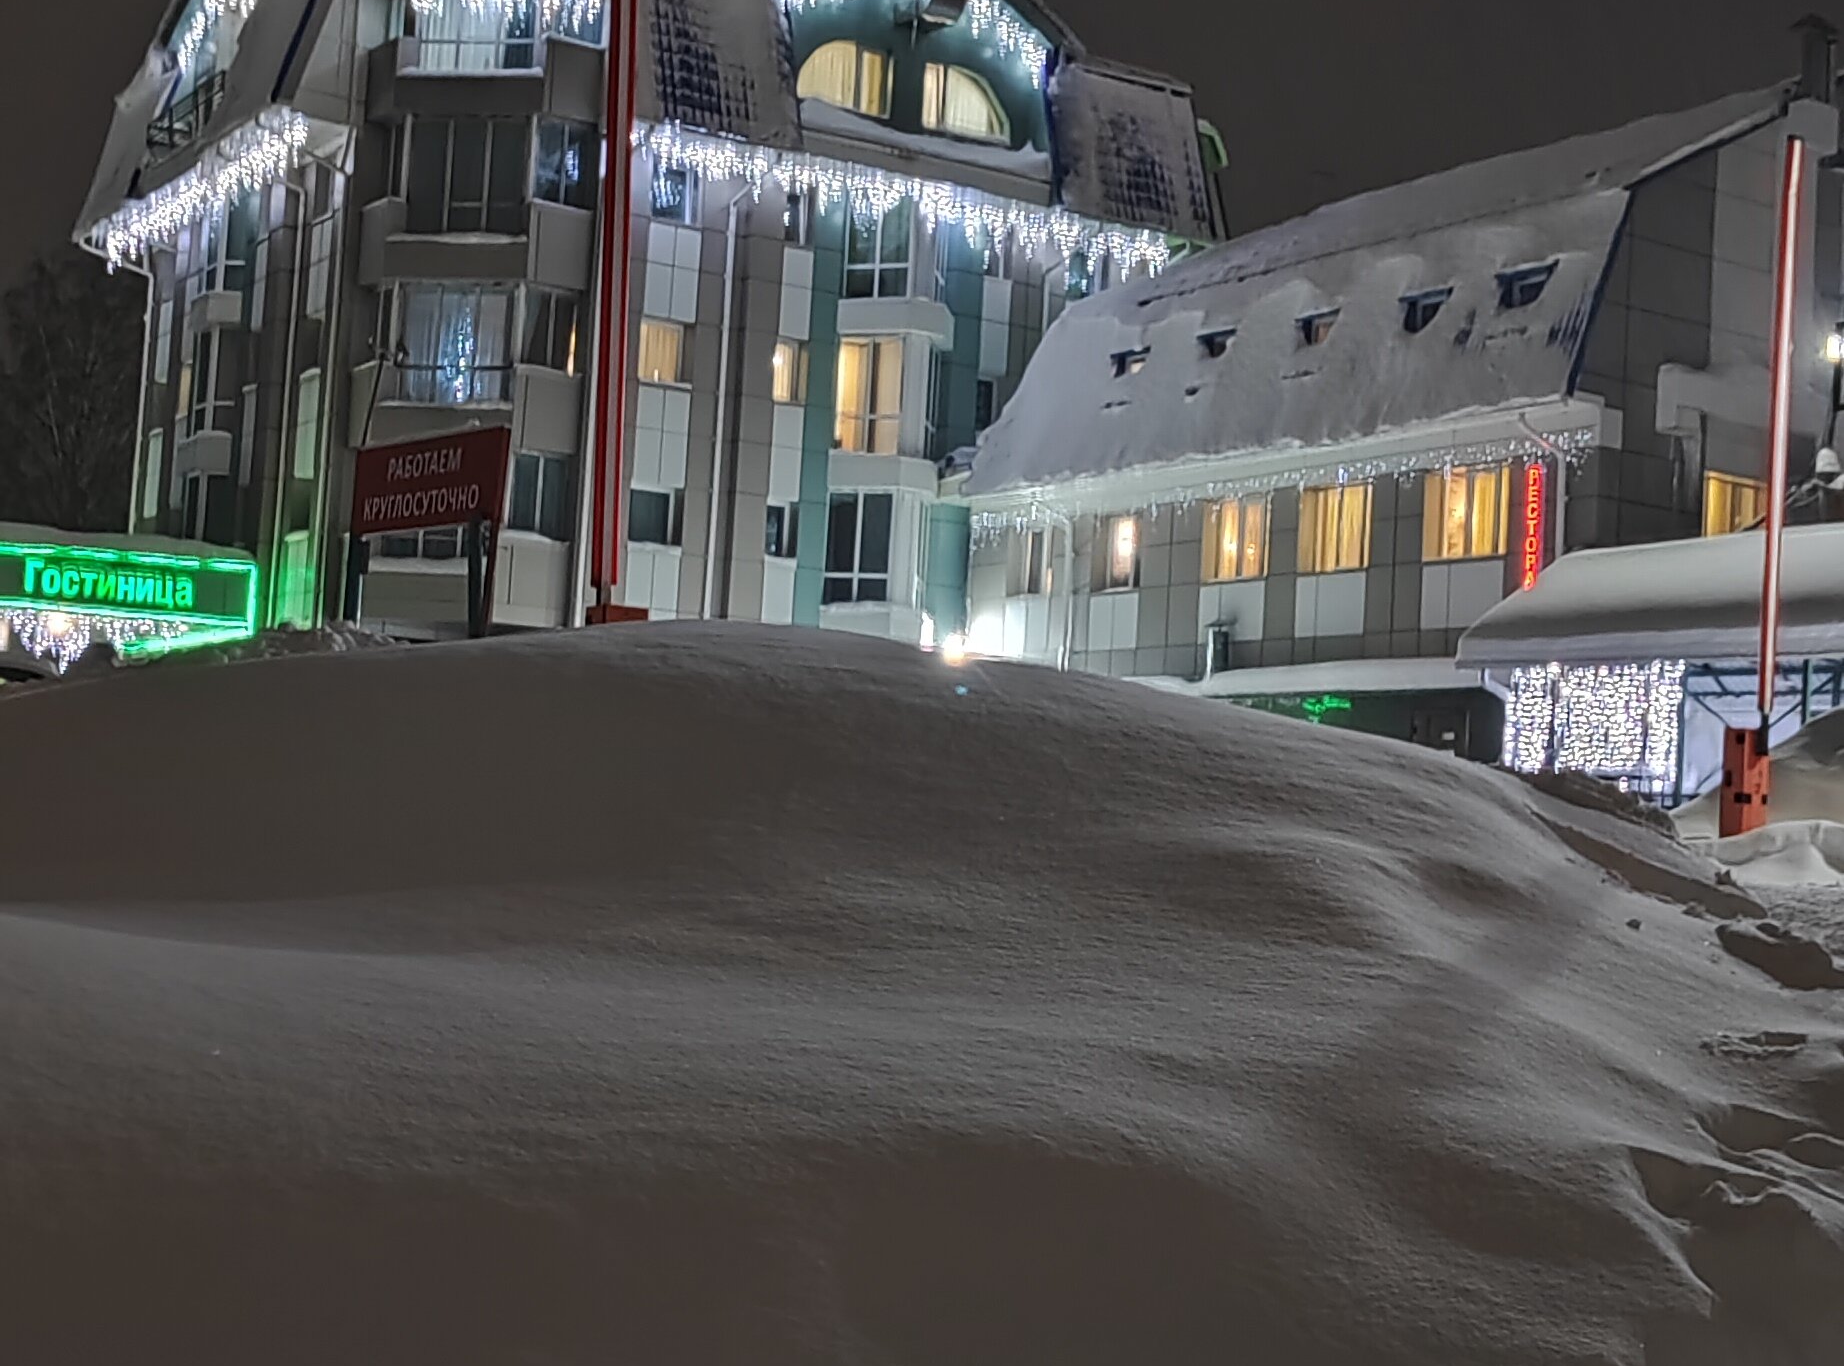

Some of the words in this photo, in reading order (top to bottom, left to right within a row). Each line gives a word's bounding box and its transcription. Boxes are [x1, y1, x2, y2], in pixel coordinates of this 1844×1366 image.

[387, 447, 462, 482] РАБОТАЕМ
[363, 484, 480, 522] КРУГЛОСУТОЧНО
[23, 556, 193, 609] Гостиница
